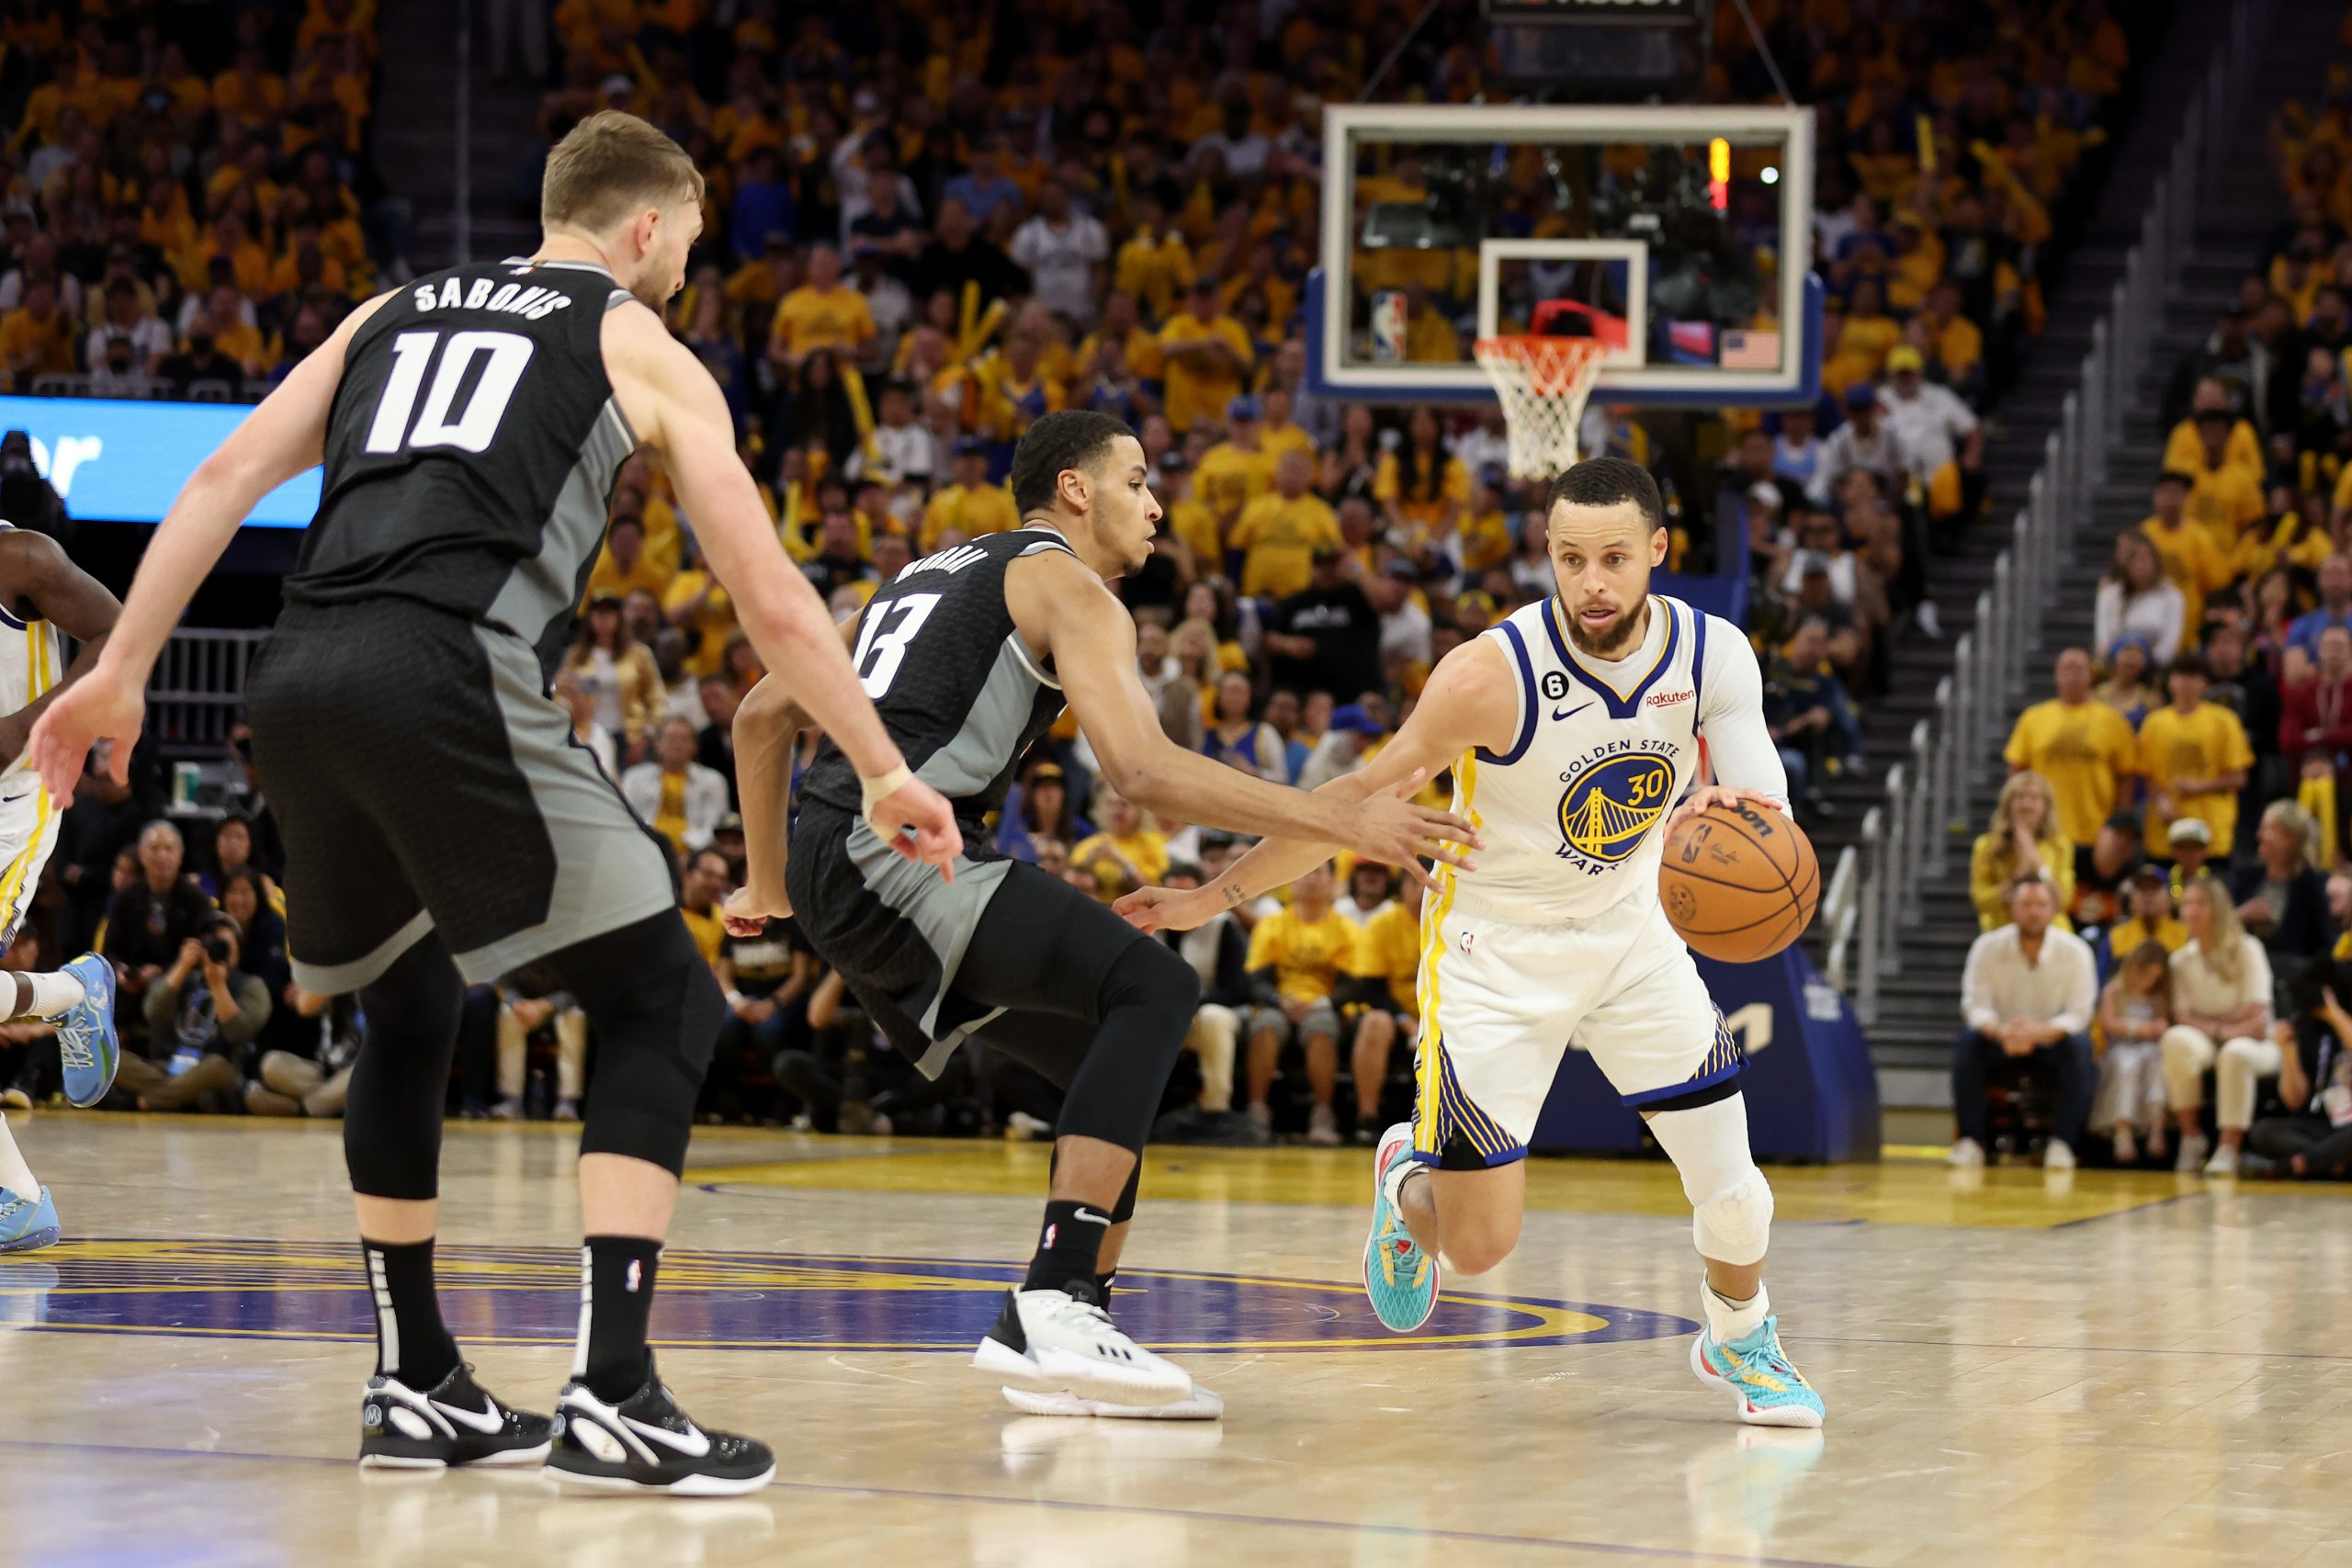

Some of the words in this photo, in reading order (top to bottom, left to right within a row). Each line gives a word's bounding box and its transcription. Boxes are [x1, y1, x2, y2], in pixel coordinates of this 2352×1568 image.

[413, 276, 571, 321] SABONIS
[365, 331, 534, 453] 10
[854, 593, 943, 699] 13
[1546, 674, 1564, 697] 6
[1646, 690, 1695, 707] Rakuten
[1559, 739, 1631, 783] GOLDEN
[1640, 739, 1679, 758] STATE
[1627, 769, 1664, 807] 30
